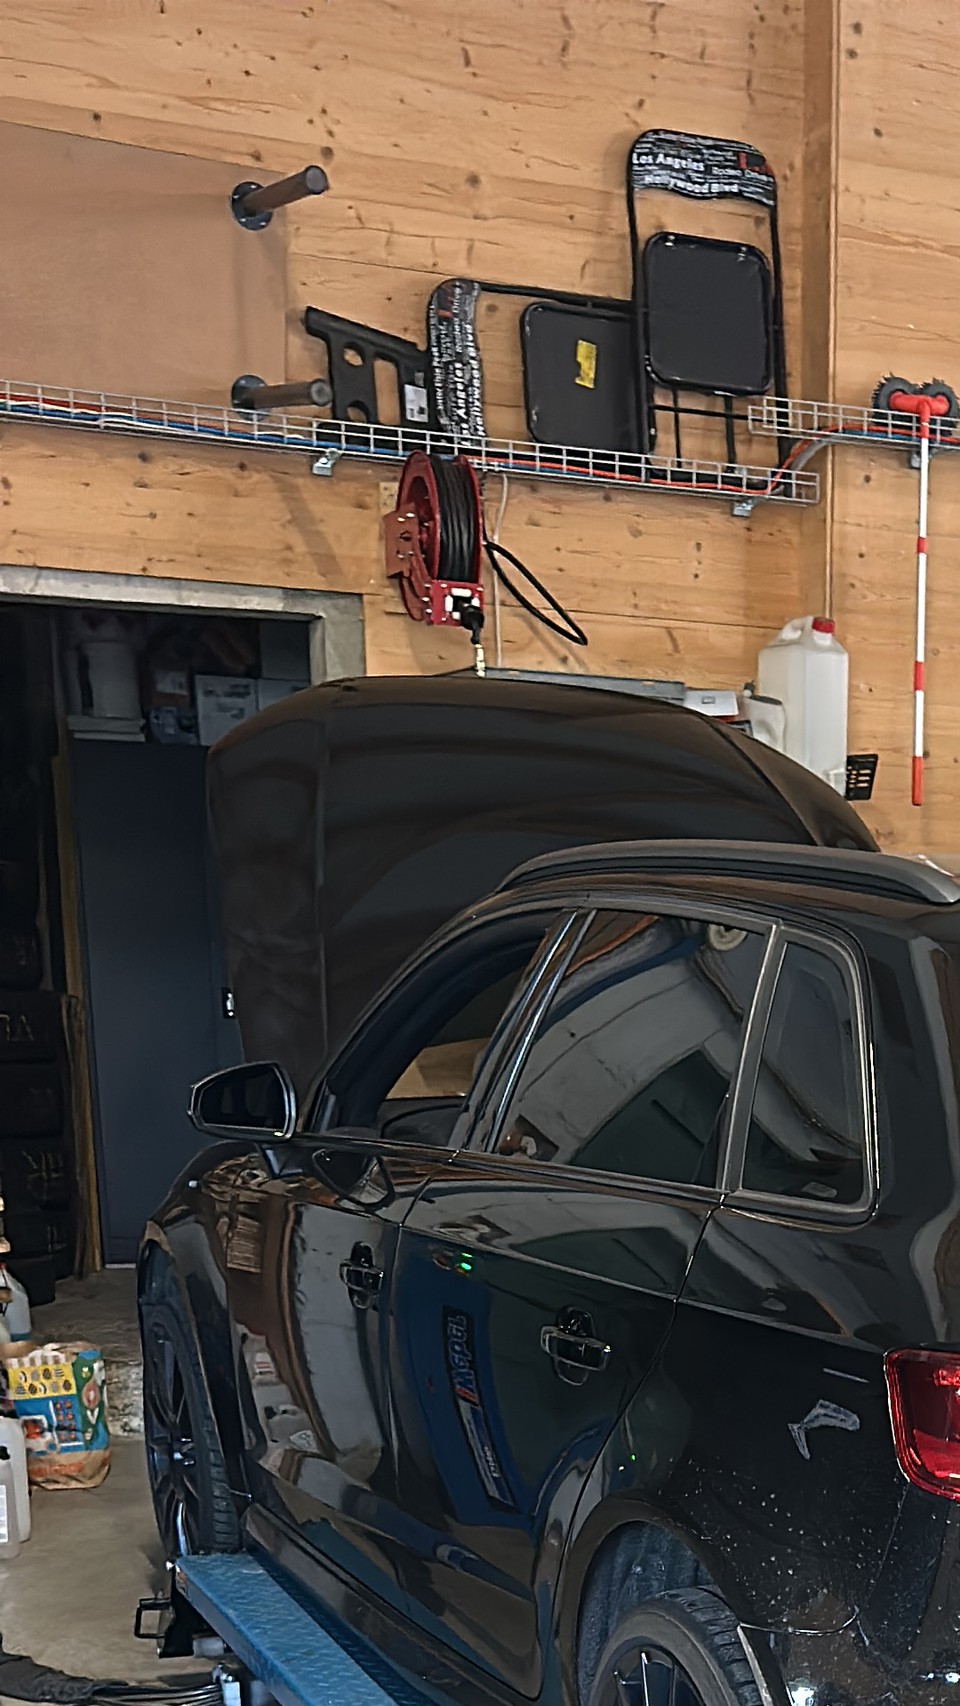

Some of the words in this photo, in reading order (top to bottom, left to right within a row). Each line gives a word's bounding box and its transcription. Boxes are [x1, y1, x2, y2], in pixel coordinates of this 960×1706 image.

[631, 152, 653, 165] Los
[655, 153, 705, 172] Angeles
[454, 362, 468, 420] Angeles
[469, 359, 487, 437] Hollywood
